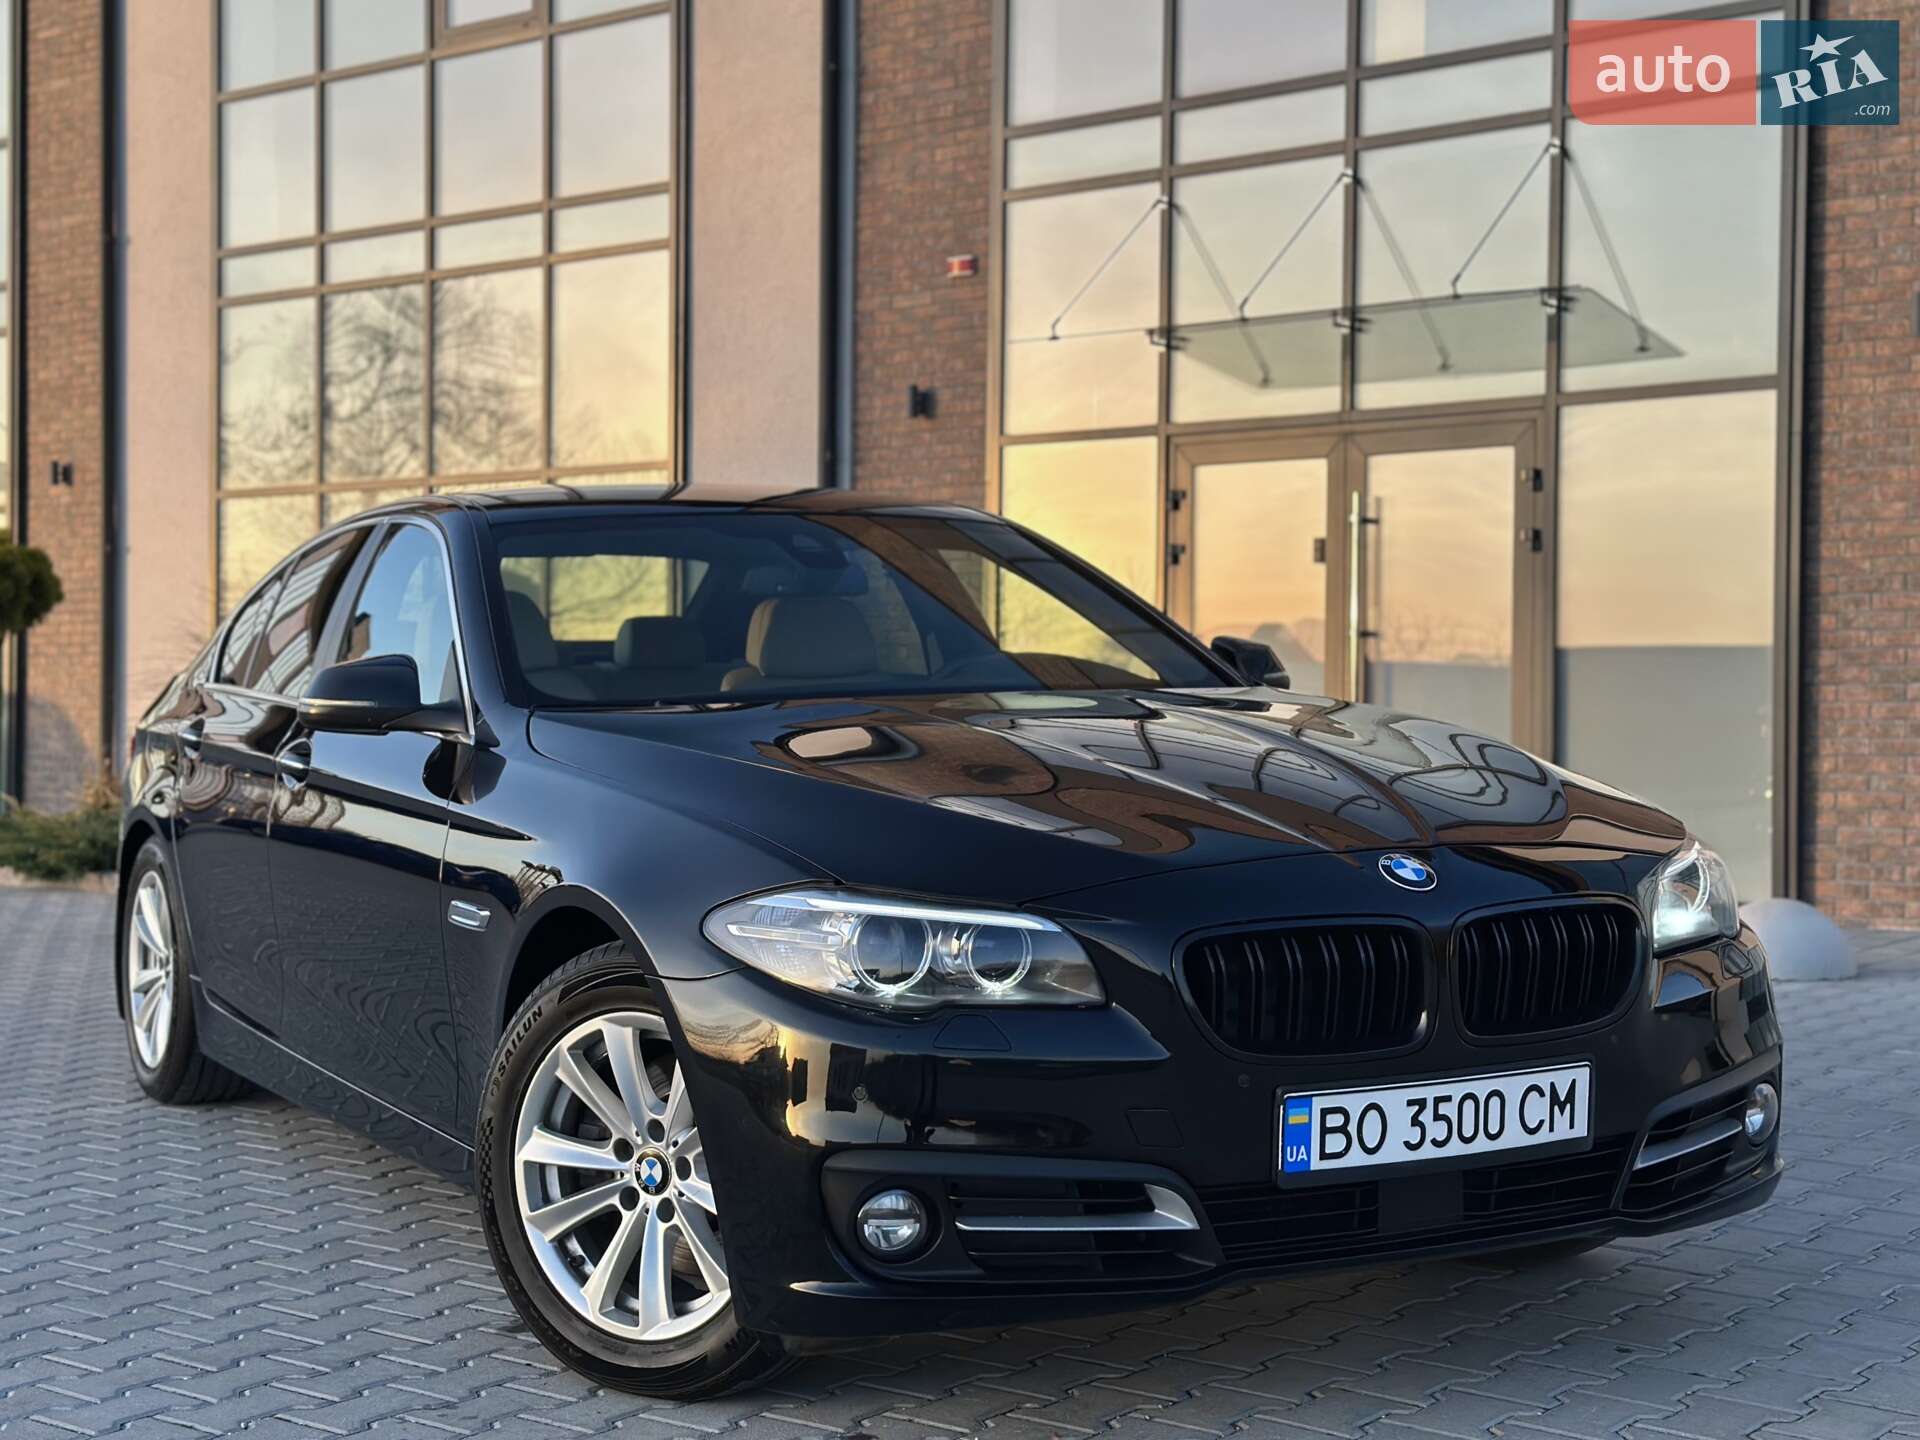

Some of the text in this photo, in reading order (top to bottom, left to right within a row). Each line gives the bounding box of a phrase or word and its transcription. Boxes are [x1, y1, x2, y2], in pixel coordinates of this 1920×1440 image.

[498, 1006, 543, 1077] SAILUN
[1286, 1145, 1308, 1163] UA
[1319, 1078, 1577, 1161] BO 3500 CM
